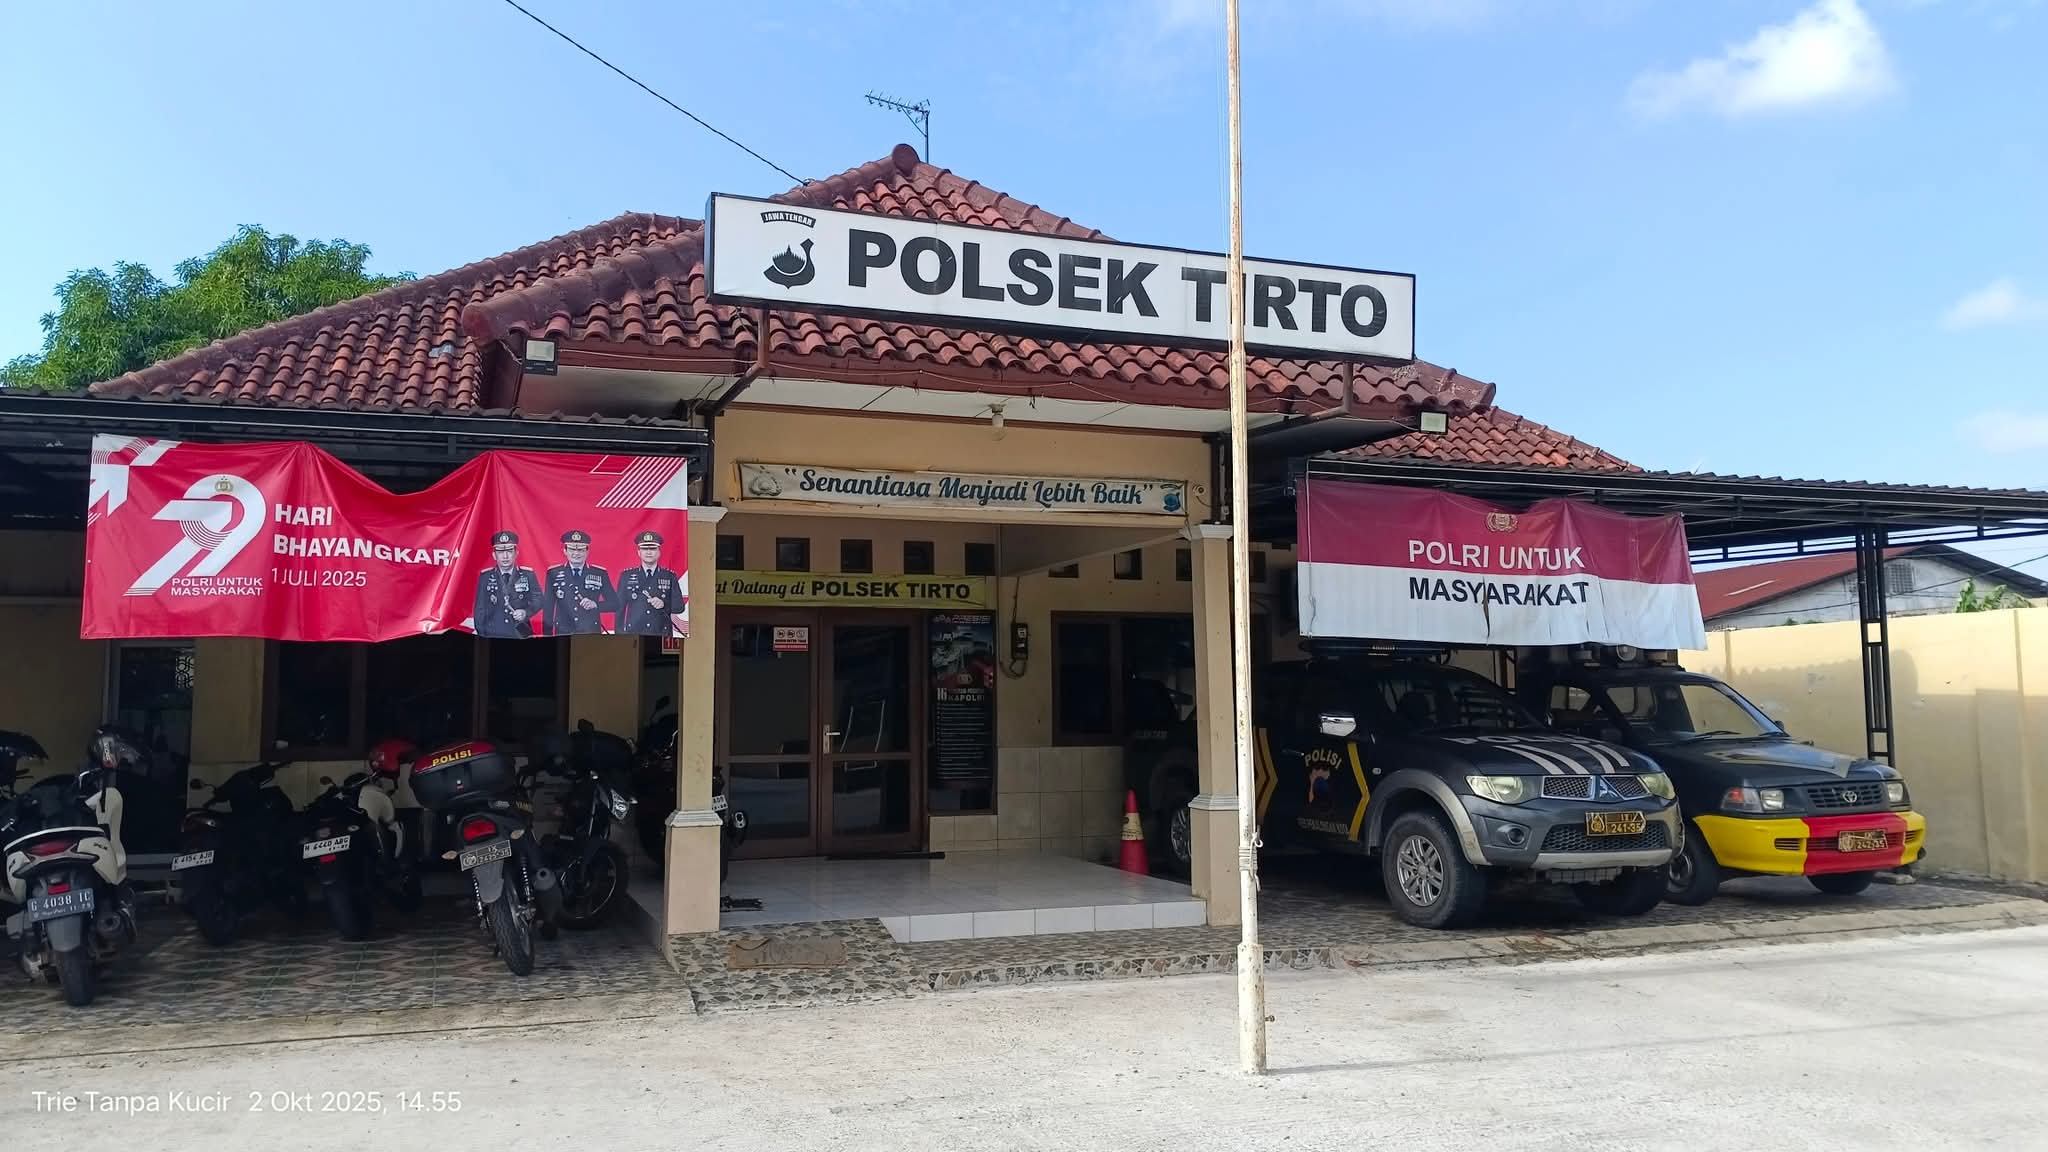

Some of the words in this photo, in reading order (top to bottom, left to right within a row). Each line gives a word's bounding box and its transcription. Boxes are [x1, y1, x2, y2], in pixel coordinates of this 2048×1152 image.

[765, 212, 785, 221] JAWA
[848, 228, 1159, 318] POLSEK
[1181, 266, 1389, 338] TRTO
[938, 476, 1027, 506] Menjadi
[1032, 480, 1086, 508] Lebih
[274, 503, 333, 527] HARI
[1408, 539, 1489, 568] POLRI
[1500, 546, 1586, 571] UNTUK
[171, 576, 214, 587] POLRI
[216, 576, 264, 587] UNTUK
[271, 567, 279, 585] 1
[280, 568, 318, 587] JULI
[320, 569, 367, 588] 2025
[170, 586, 264, 597] MASYARAKAT
[790, 581, 806, 595] di
[811, 581, 900, 599] POLSEK
[906, 582, 971, 599] TIRTO
[1409, 576, 1590, 606] MASYARAKAT
[431, 749, 473, 767] POLISI
[1304, 747, 1343, 770] POLISI
[31, 900, 38, 912] G
[43, 894, 72, 909] 4038
